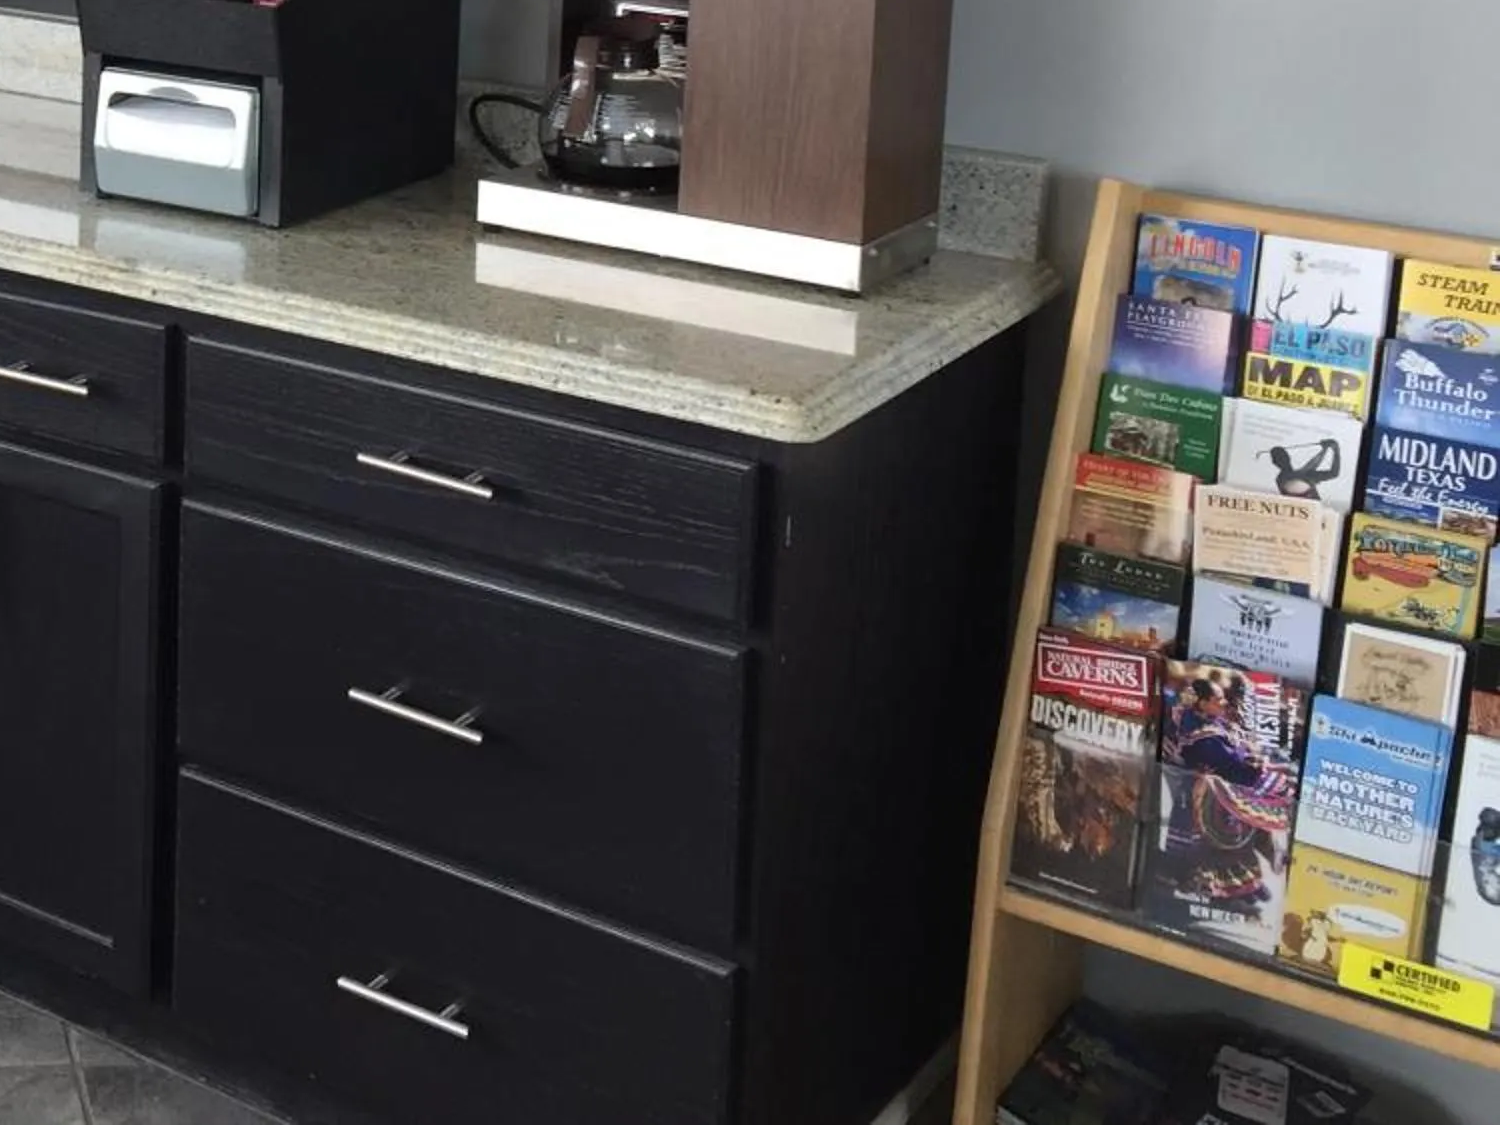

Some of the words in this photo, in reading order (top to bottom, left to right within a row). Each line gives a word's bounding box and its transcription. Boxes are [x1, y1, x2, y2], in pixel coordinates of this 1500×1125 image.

[1416, 273, 1490, 296] STEAM
[1128, 301, 1177, 318] SANTA
[1275, 328, 1300, 349] EL
[1306, 329, 1365, 360] PASO
[1248, 357, 1361, 397] MAP
[1404, 372, 1489, 403] Buffalo
[1394, 388, 1499, 421] Thunder
[1378, 433, 1498, 482] MIDLAND
[1377, 478, 1407, 494] Feel
[1410, 480, 1433, 503] the
[1406, 466, 1467, 492] TEXAS
[1207, 494, 1257, 512] FREE
[1259, 500, 1311, 520] NUTS
[1046, 661, 1140, 688] CAVERNS
[1047, 650, 1091, 667] NATURAL
[1095, 657, 1136, 673] BRIDGE
[1031, 693, 1144, 755] DISCOVERY
[1255, 682, 1281, 749] MESILLA
[1320, 758, 1396, 789] WELCOME
[1398, 780, 1418, 795] TO
[1314, 789, 1414, 828] NATURE'S
[1319, 774, 1415, 812] MOTHER
[1311, 807, 1413, 844] BACKYARD
[1396, 963, 1461, 994] CERTIFIED
